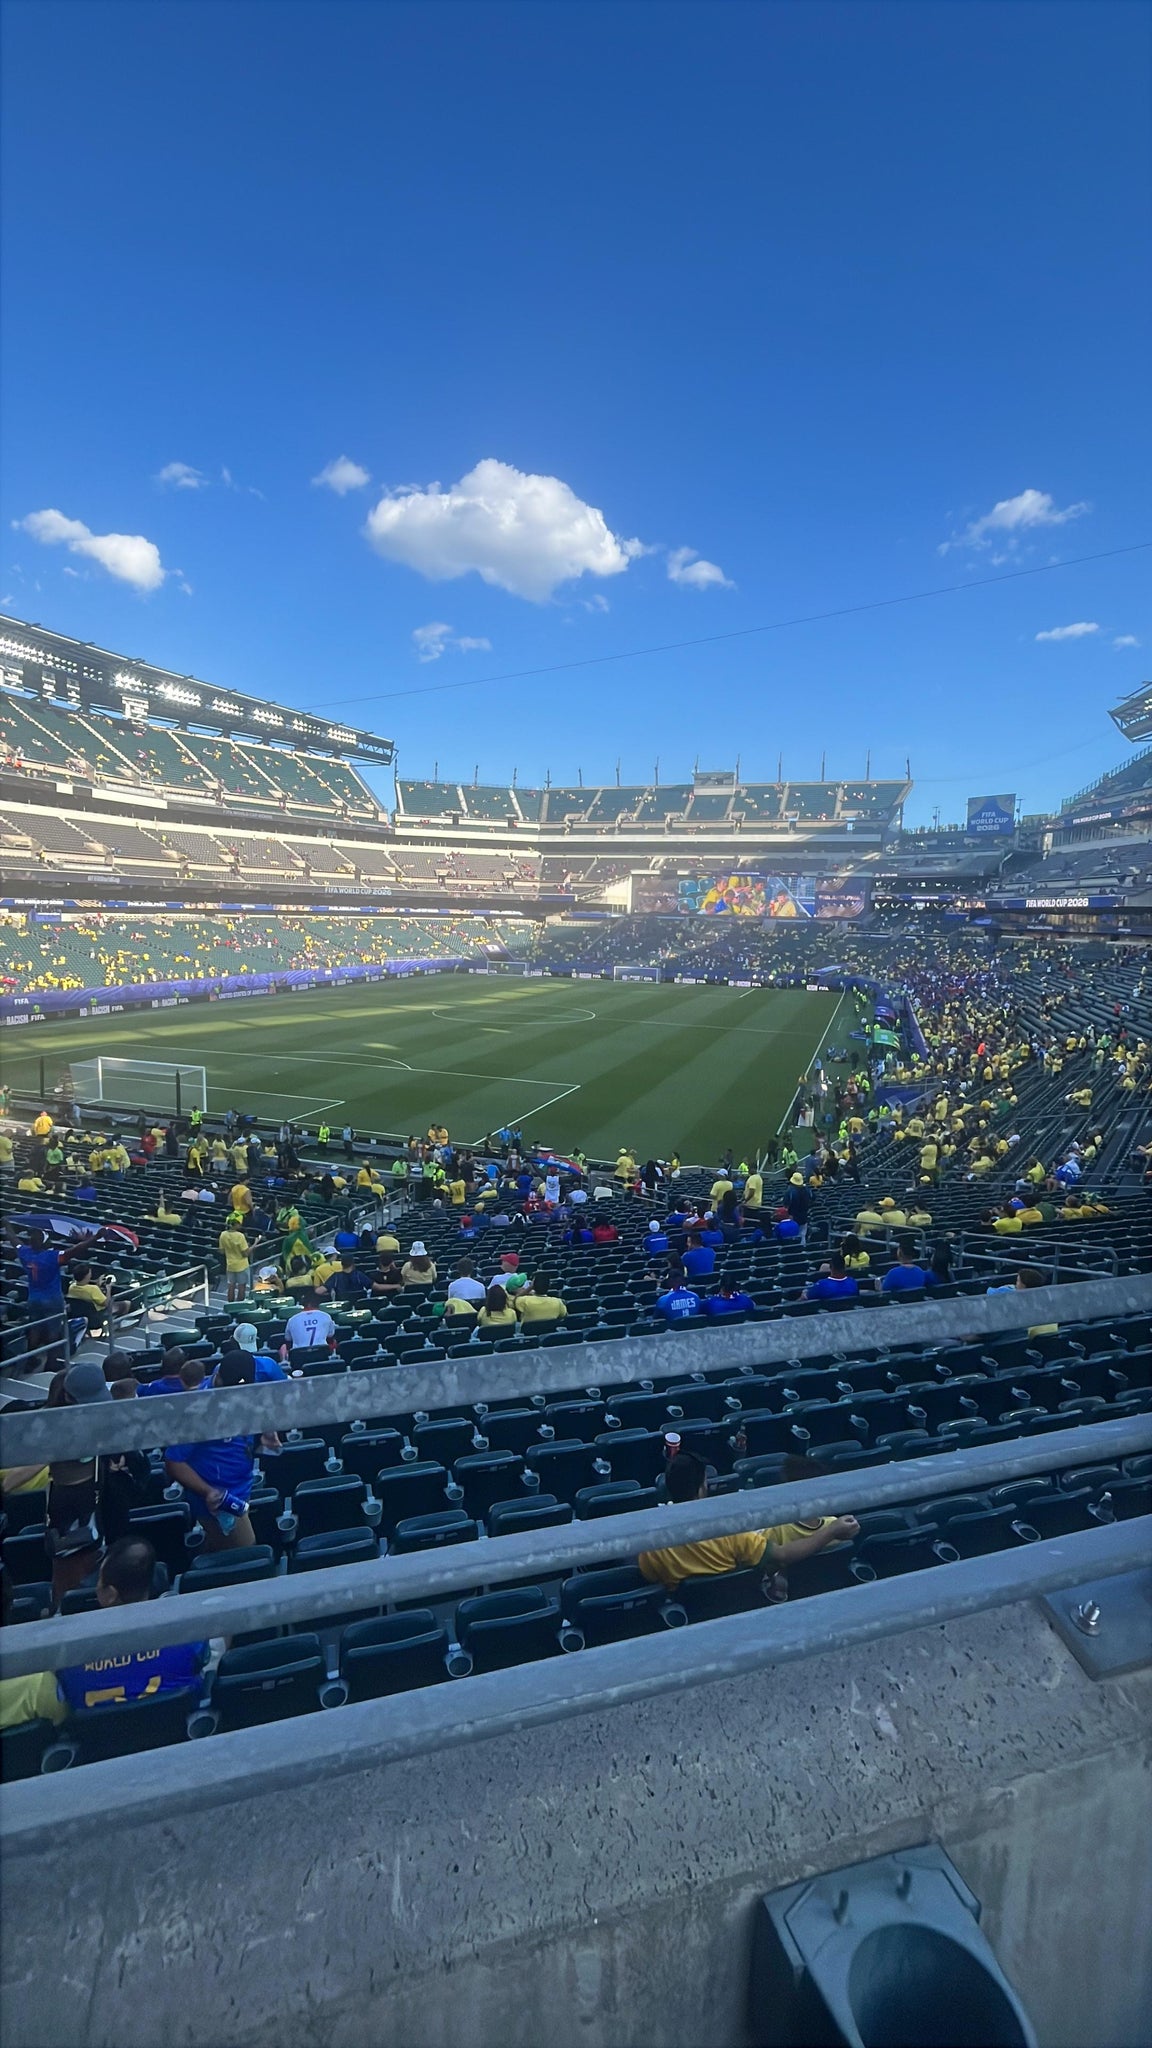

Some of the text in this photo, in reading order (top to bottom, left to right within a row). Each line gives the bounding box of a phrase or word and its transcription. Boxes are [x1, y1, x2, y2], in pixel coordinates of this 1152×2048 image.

[1026, 898, 1089, 907] FIFA WORLD CUP 2026
[14, 998, 29, 1006] FIFA
[6, 1014, 28, 1025] RACISM
[671, 1297, 696, 1310] JAMES
[306, 1327, 316, 1346] 7
